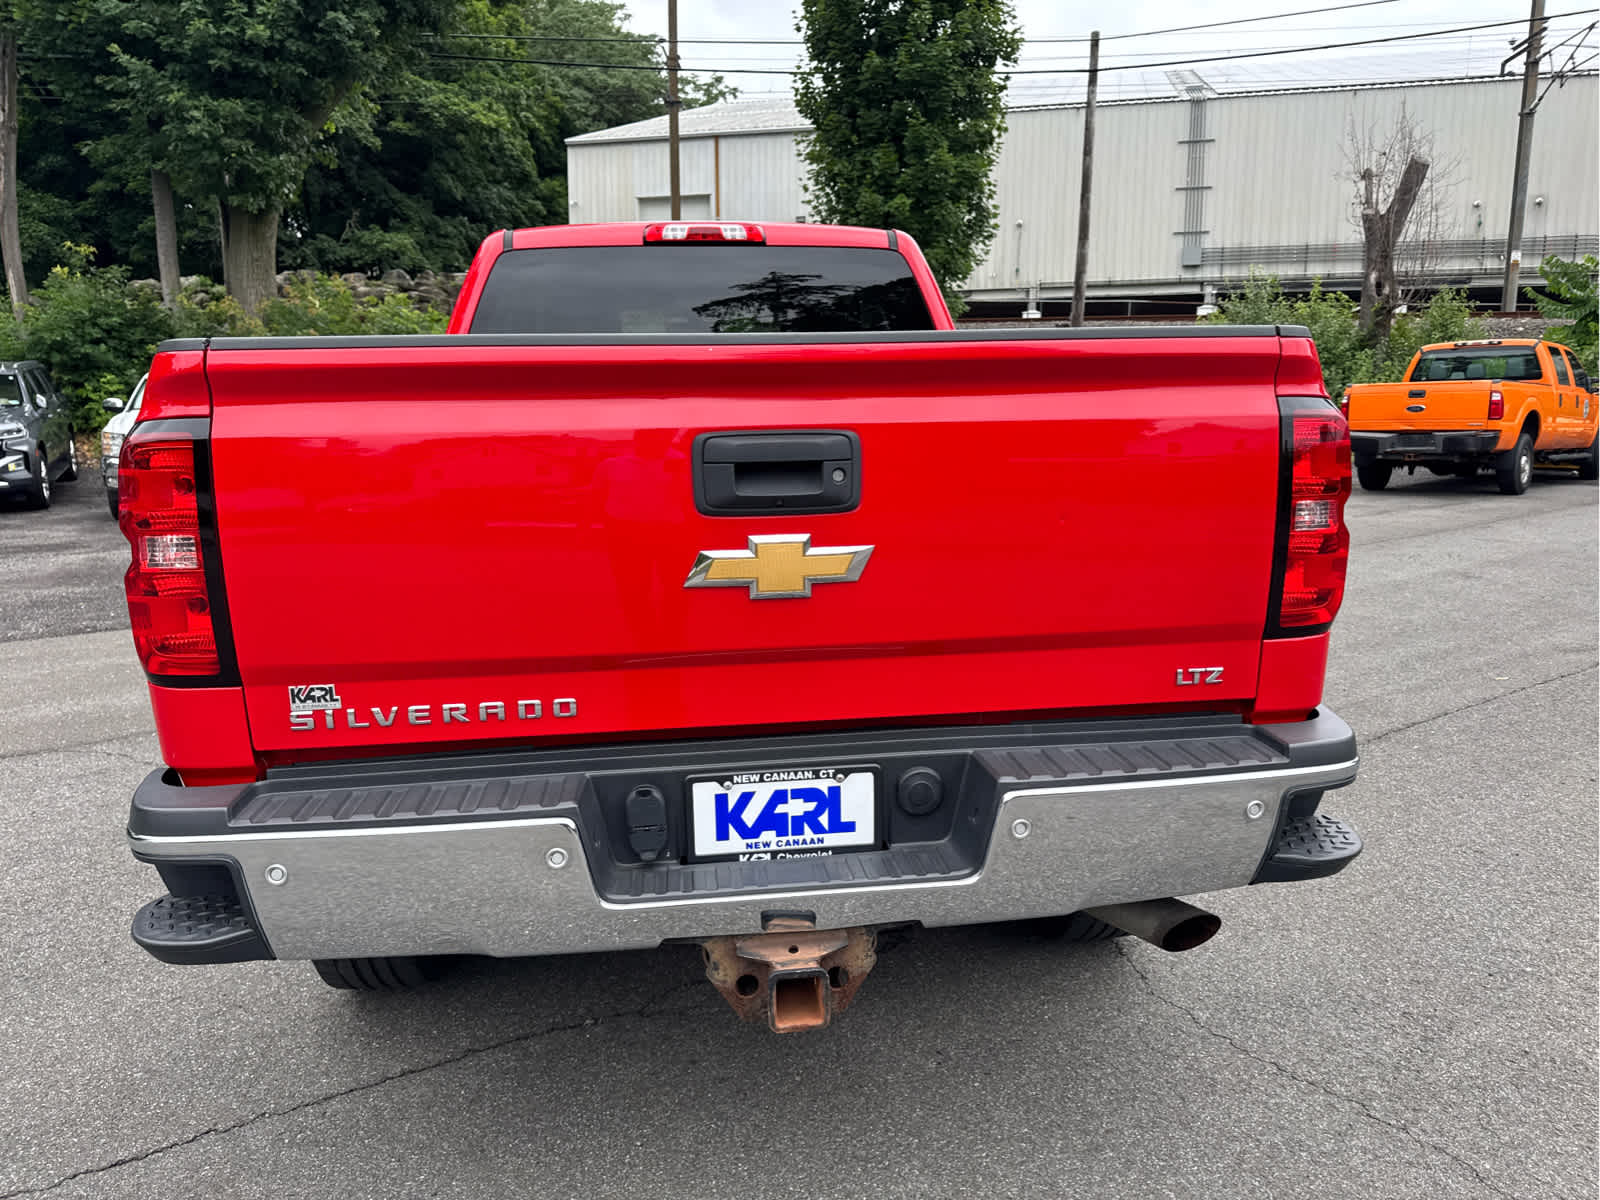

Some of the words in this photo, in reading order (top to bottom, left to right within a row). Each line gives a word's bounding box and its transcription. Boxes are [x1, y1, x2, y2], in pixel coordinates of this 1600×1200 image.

[1176, 666, 1224, 685] LTZ
[289, 686, 340, 704] KARL
[289, 697, 577, 731] SILVERADO
[733, 774, 760, 784] NEW
[819, 769, 835, 778] CT
[714, 785, 856, 841] KARL
[745, 841, 771, 850] NEW
[775, 837, 825, 848] CANAAN
